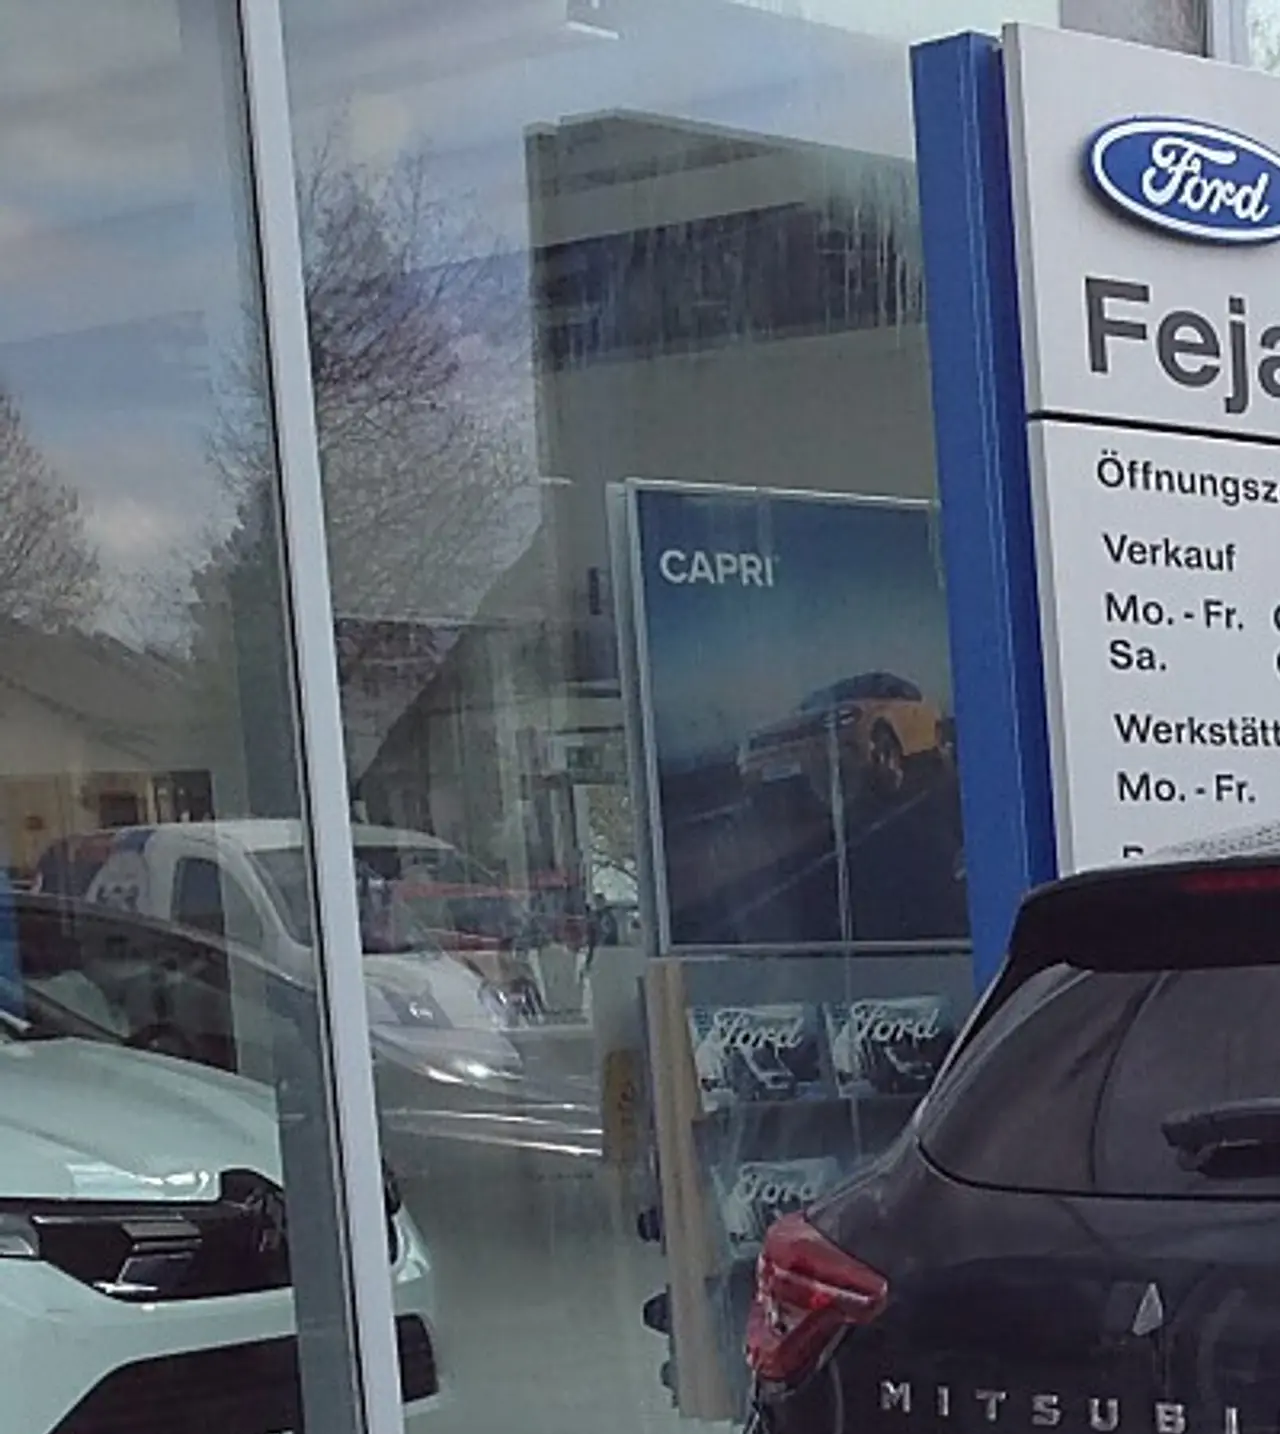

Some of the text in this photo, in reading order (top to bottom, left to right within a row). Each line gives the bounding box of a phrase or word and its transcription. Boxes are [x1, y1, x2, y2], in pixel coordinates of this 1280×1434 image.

[1142, 137, 1270, 222] Ford
[660, 549, 773, 588] CAPRI
[1102, 533, 1235, 571] Verkauf
[1105, 592, 1174, 626] Mo.
[1204, 599, 1244, 631] Fr.
[1109, 639, 1167, 671] Sa.
[1117, 771, 1186, 802] Mo.
[1215, 773, 1256, 803] Fr.
[852, 1001, 941, 1044] Ford
